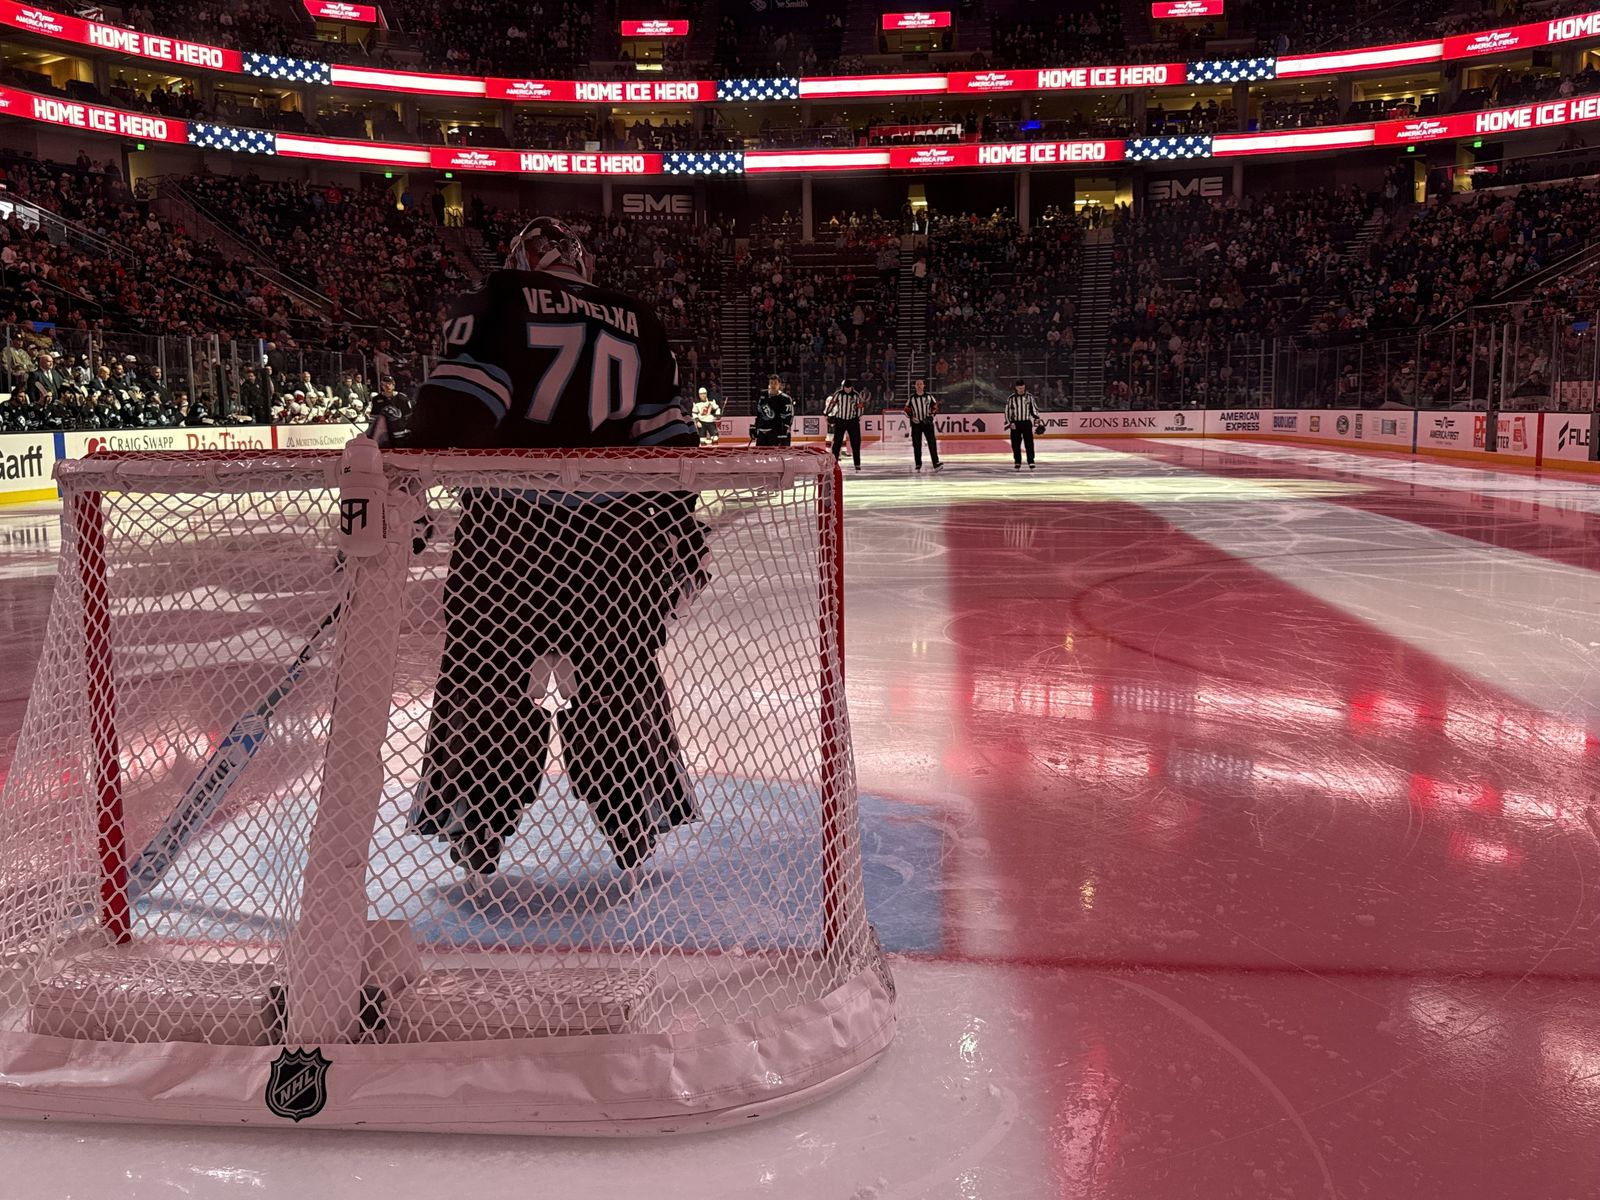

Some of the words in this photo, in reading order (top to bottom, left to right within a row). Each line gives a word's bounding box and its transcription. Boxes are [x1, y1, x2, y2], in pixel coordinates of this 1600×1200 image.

[344, 10, 360, 18] FIRST
[16, 15, 43, 28] AMERICA
[44, 22, 63, 33] FIRST
[1547, 13, 1600, 42] HOME
[89, 24, 140, 54] HOME
[143, 36, 172, 60] ICE
[175, 42, 223, 69] HERO
[1466, 41, 1497, 51] AMERICA
[1498, 37, 1519, 47] FIRST
[1038, 70, 1086, 88] HOME
[1090, 68, 1116, 86] ICE
[1120, 66, 1167, 85] HERO
[506, 88, 533, 96] AMERICA
[575, 83, 622, 101] HOME
[626, 83, 651, 101] ICE
[654, 83, 699, 100] HERO
[34, 98, 85, 126] HOME
[88, 108, 116, 132] ICE
[119, 113, 167, 139] HERO
[1475, 108, 1532, 133] HOME
[1536, 102, 1565, 125] ICE
[1570, 96, 1600, 120] HE
[1396, 129, 1427, 138] AMERICA
[1427, 127, 1448, 135] FIRST
[451, 158, 478, 166] AMERICA
[478, 159, 496, 167] FIRST
[978, 146, 1026, 164] HOME
[1030, 145, 1056, 162] ICE
[1059, 143, 1105, 161] HERO
[520, 154, 568, 172] HOME
[571, 155, 597, 172] ICE
[600, 156, 644, 173] HERO
[1148, 176, 1223, 200] SME
[622, 193, 693, 213] SME
[522, 287, 639, 337] VEJMELKA
[524, 322, 641, 433] 70
[865, 420, 907, 431] ELTA
[935, 417, 969, 433] vint
[1080, 417, 1118, 428] ZIONS
[1122, 417, 1156, 427] BANK
[1220, 412, 1259, 421] AMERICAN
[1226, 422, 1259, 432] EXPRESS
[109, 436, 141, 451] CRAIG
[143, 435, 174, 449] SWAPP
[280, 1069, 315, 1106] NHL
